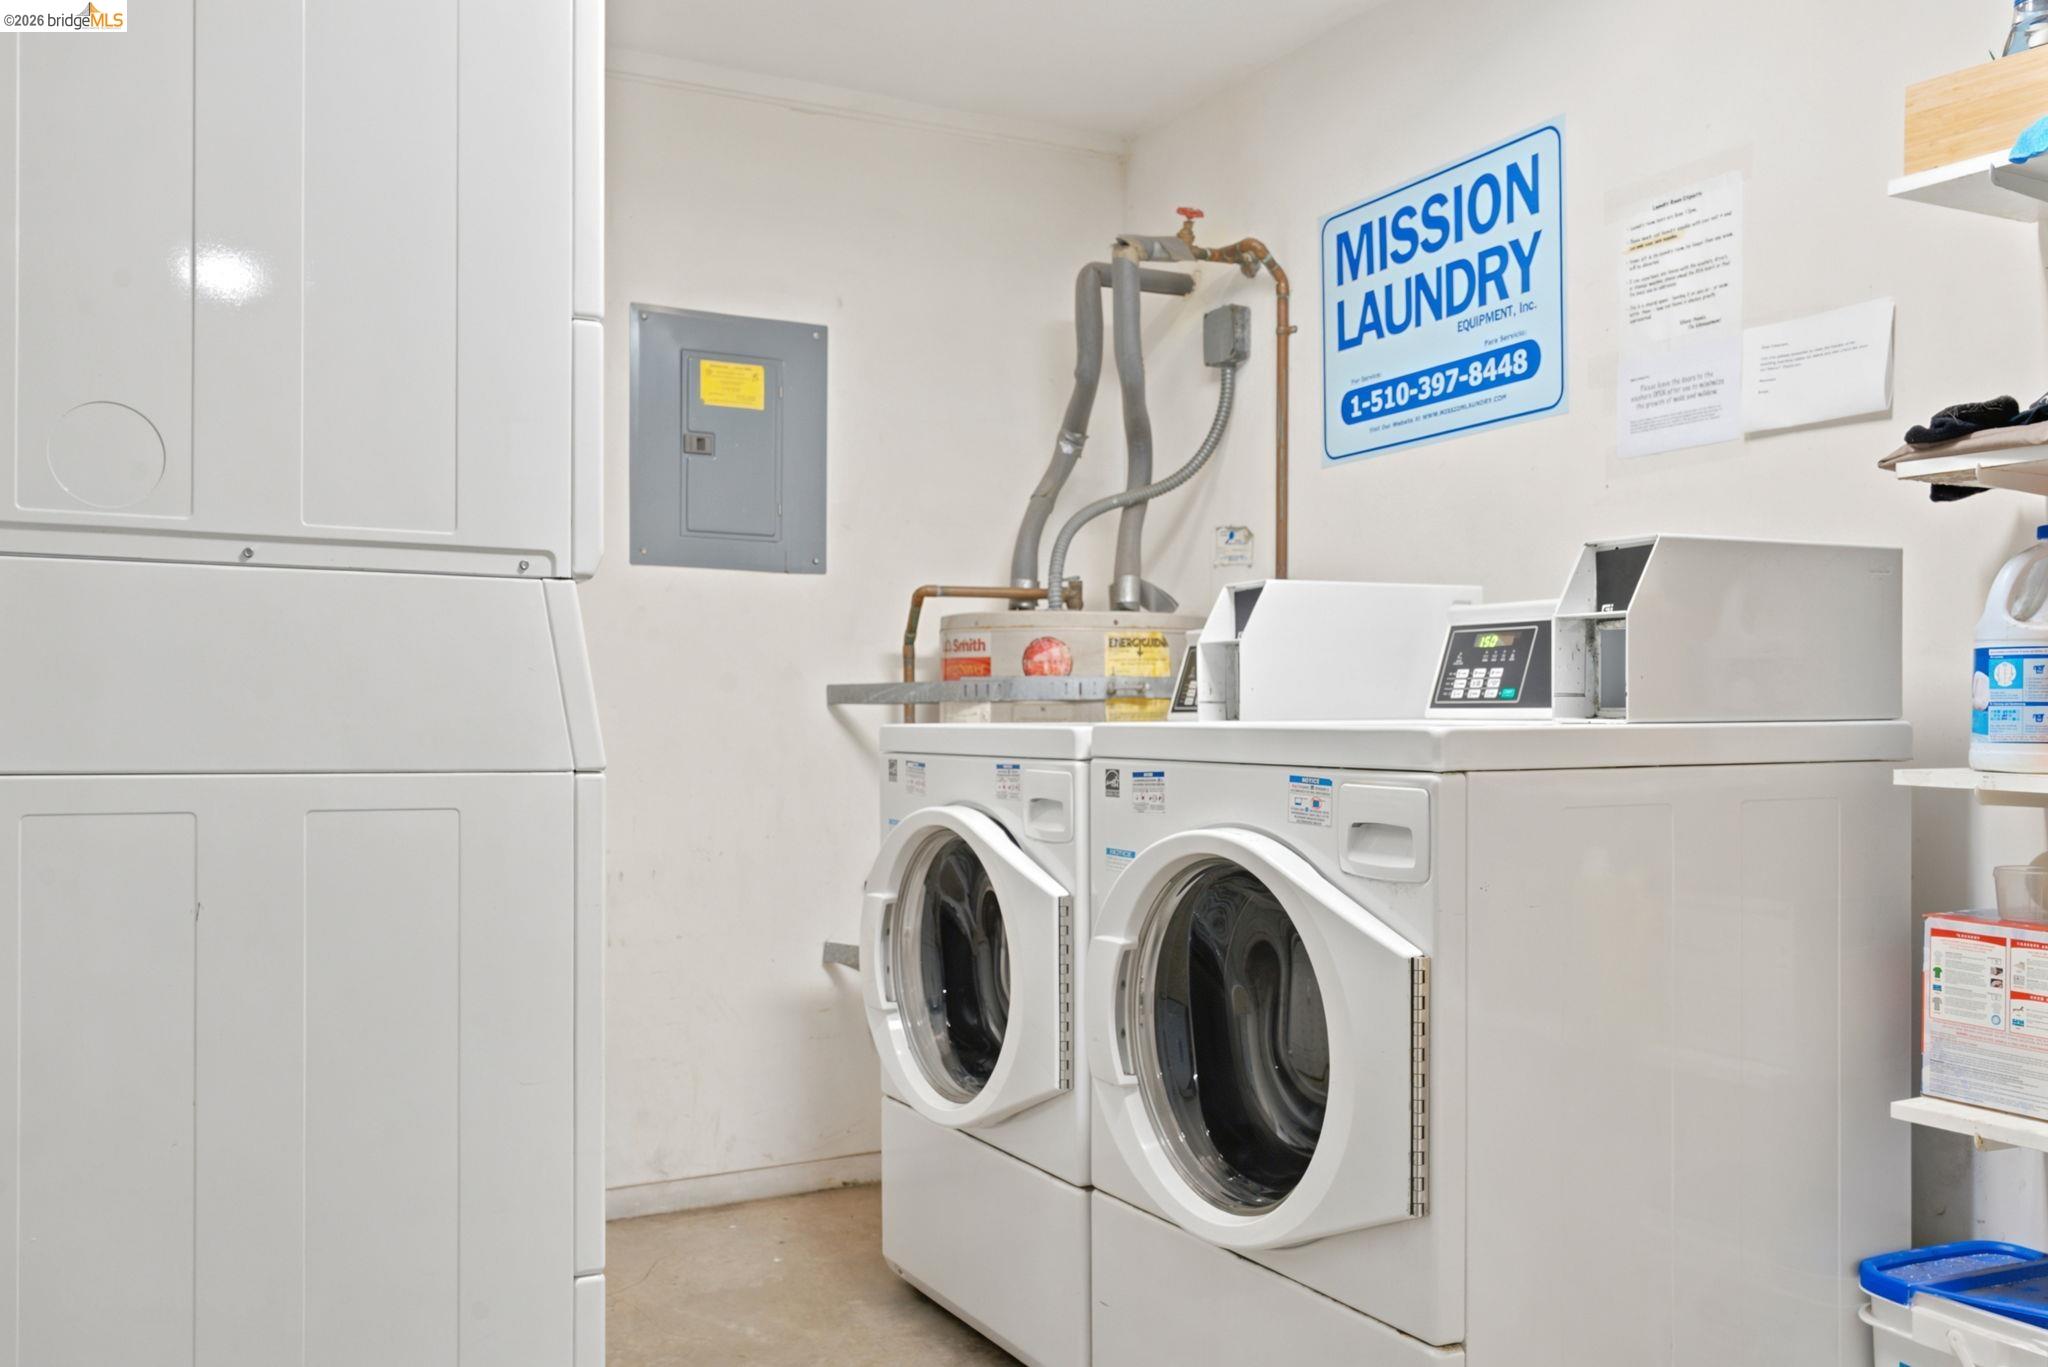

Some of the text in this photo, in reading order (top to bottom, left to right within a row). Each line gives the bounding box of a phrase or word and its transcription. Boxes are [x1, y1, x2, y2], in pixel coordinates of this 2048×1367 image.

[1336, 153, 1539, 287] MISSION
[1337, 229, 1543, 352] LAUNDRY
[1457, 300, 1537, 333] EQUIPMENT, Inc.
[1350, 348, 1529, 418] 1-510-397-8448
